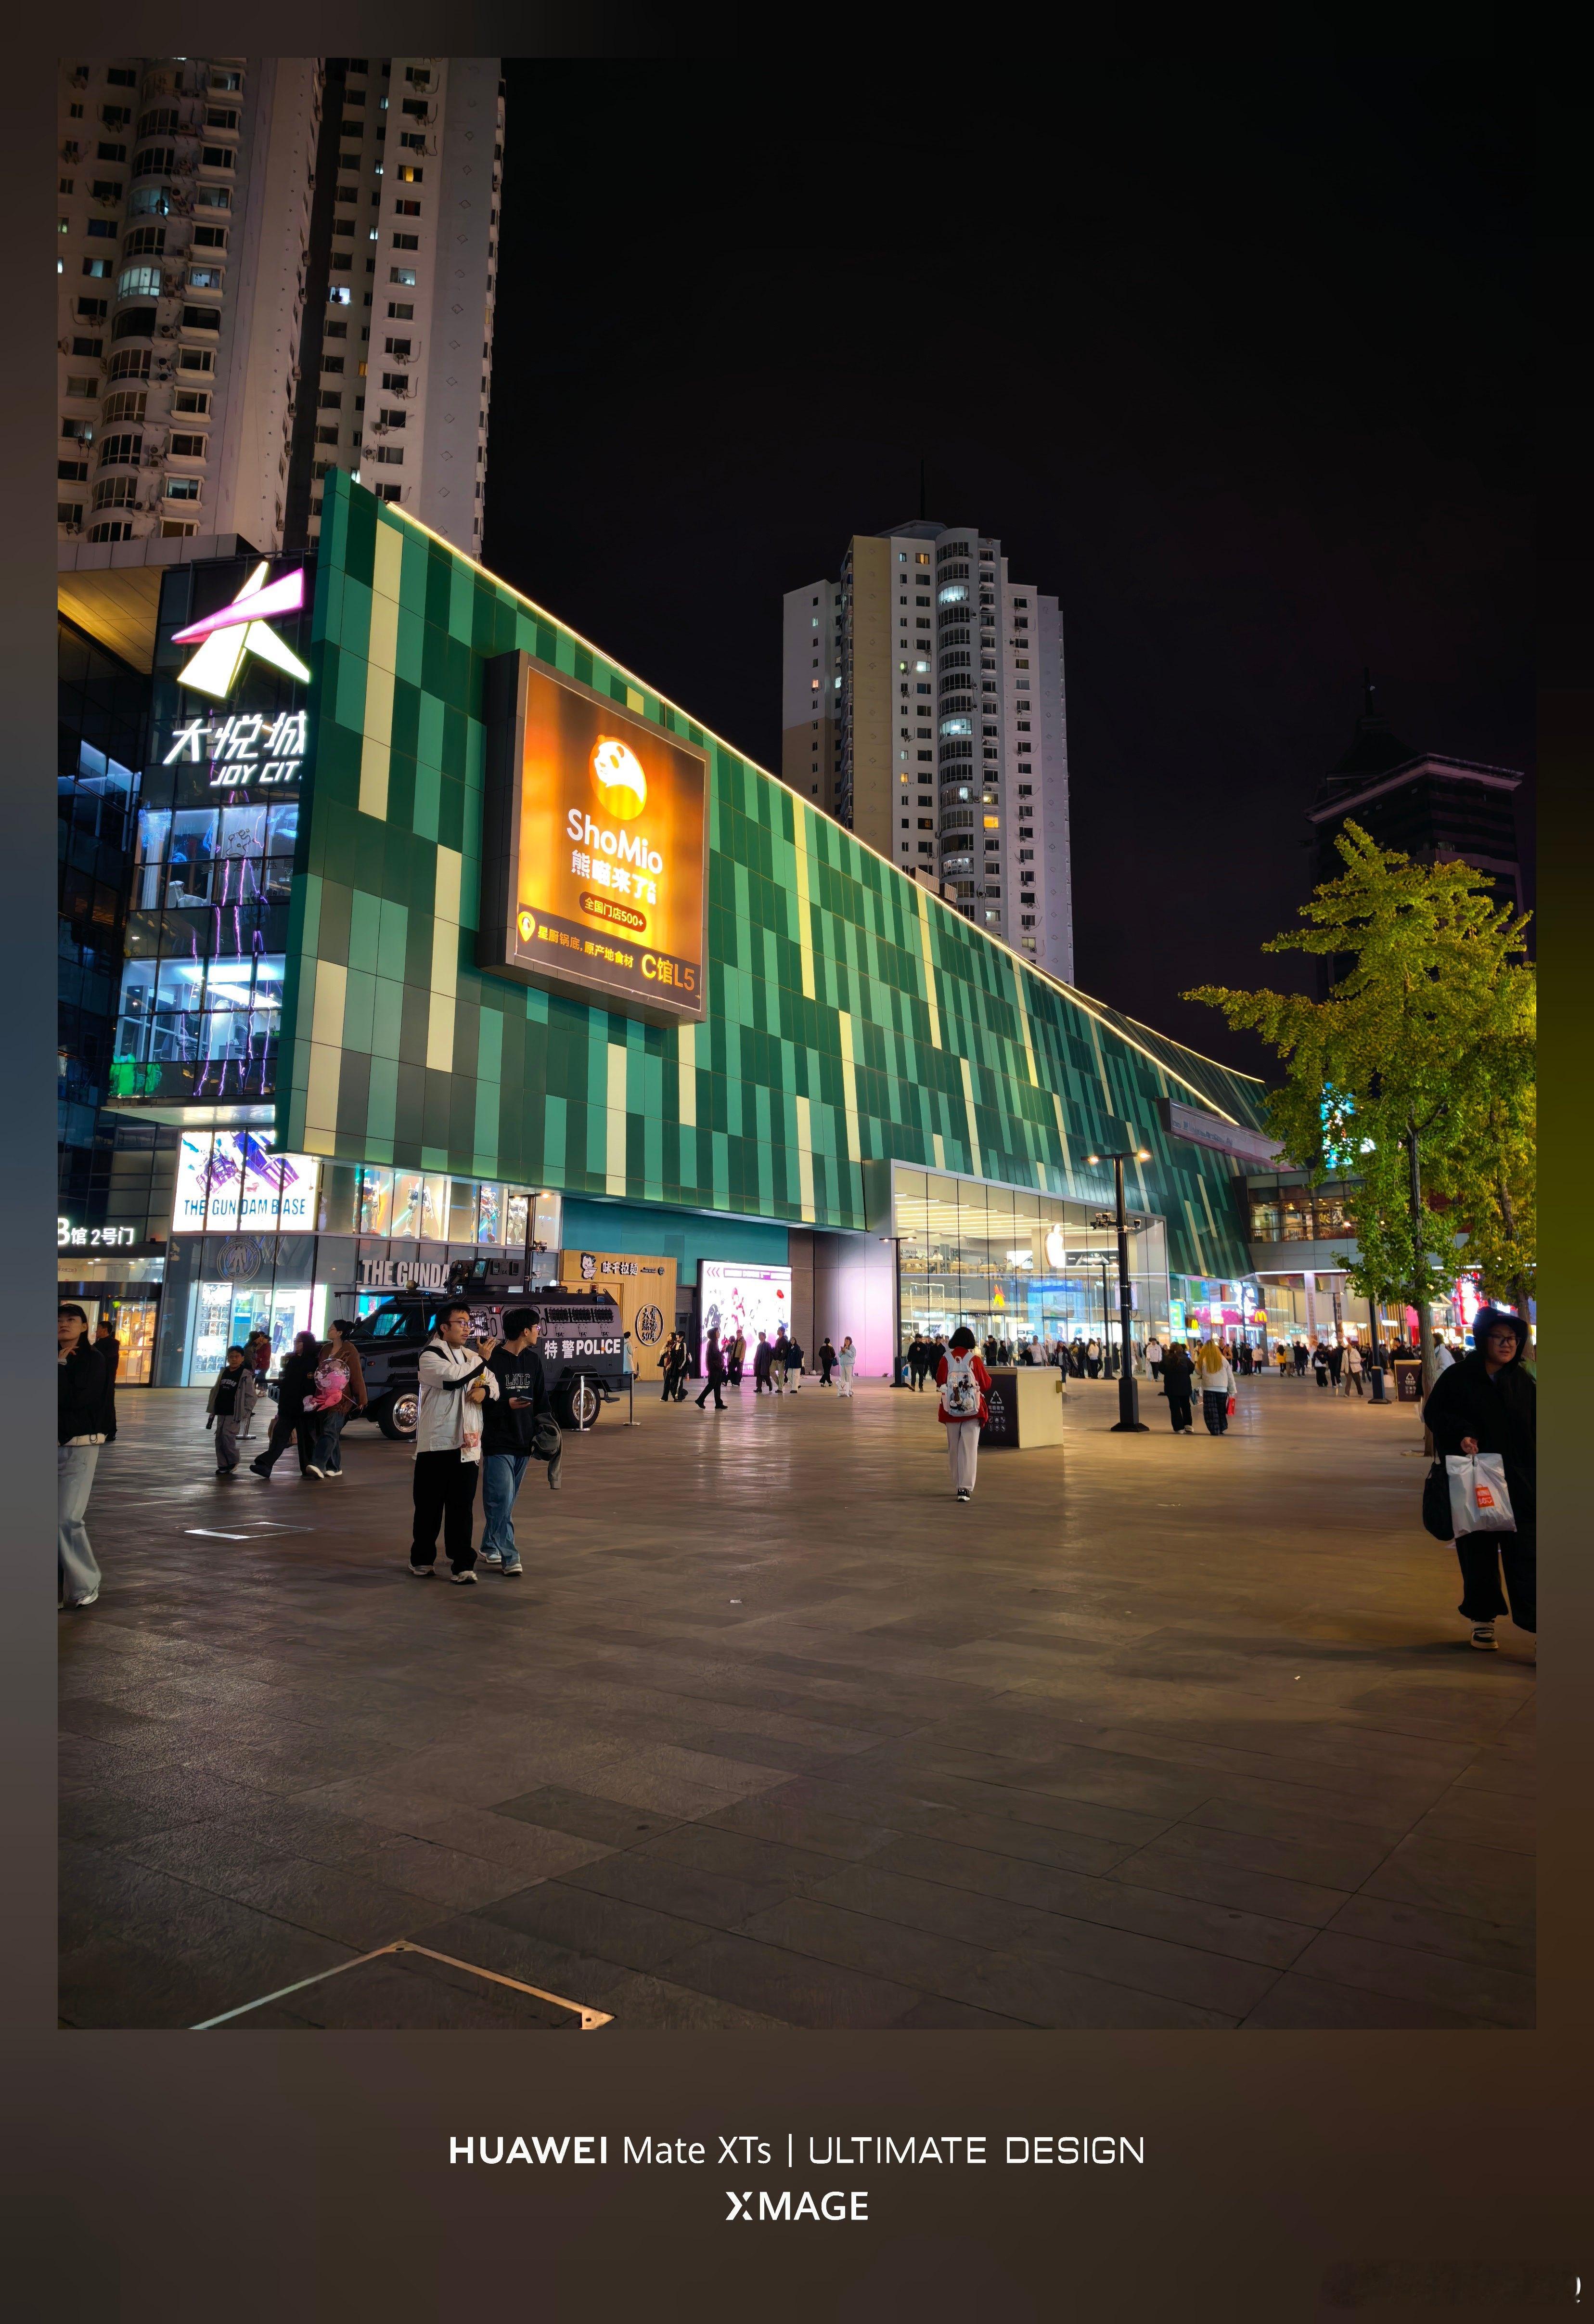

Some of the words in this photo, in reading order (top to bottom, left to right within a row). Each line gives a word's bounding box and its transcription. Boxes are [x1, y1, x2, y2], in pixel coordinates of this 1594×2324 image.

[163, 711, 306, 764] 大悦城
[210, 763, 257, 786] JOY
[259, 761, 303, 781] CIT
[567, 808, 663, 874] ShoMio
[584, 897, 644, 927] 全国门店500+
[642, 954, 695, 991] C馆L5
[184, 1200, 206, 1215] THE
[212, 1199, 268, 1215] GUNDAM
[271, 1199, 305, 1214] BASE
[362, 1259, 394, 1285] THE
[397, 1261, 450, 1288] GUNDA
[576, 1339, 621, 1356] POLICE
[505, 1373, 530, 1386] LNTC
